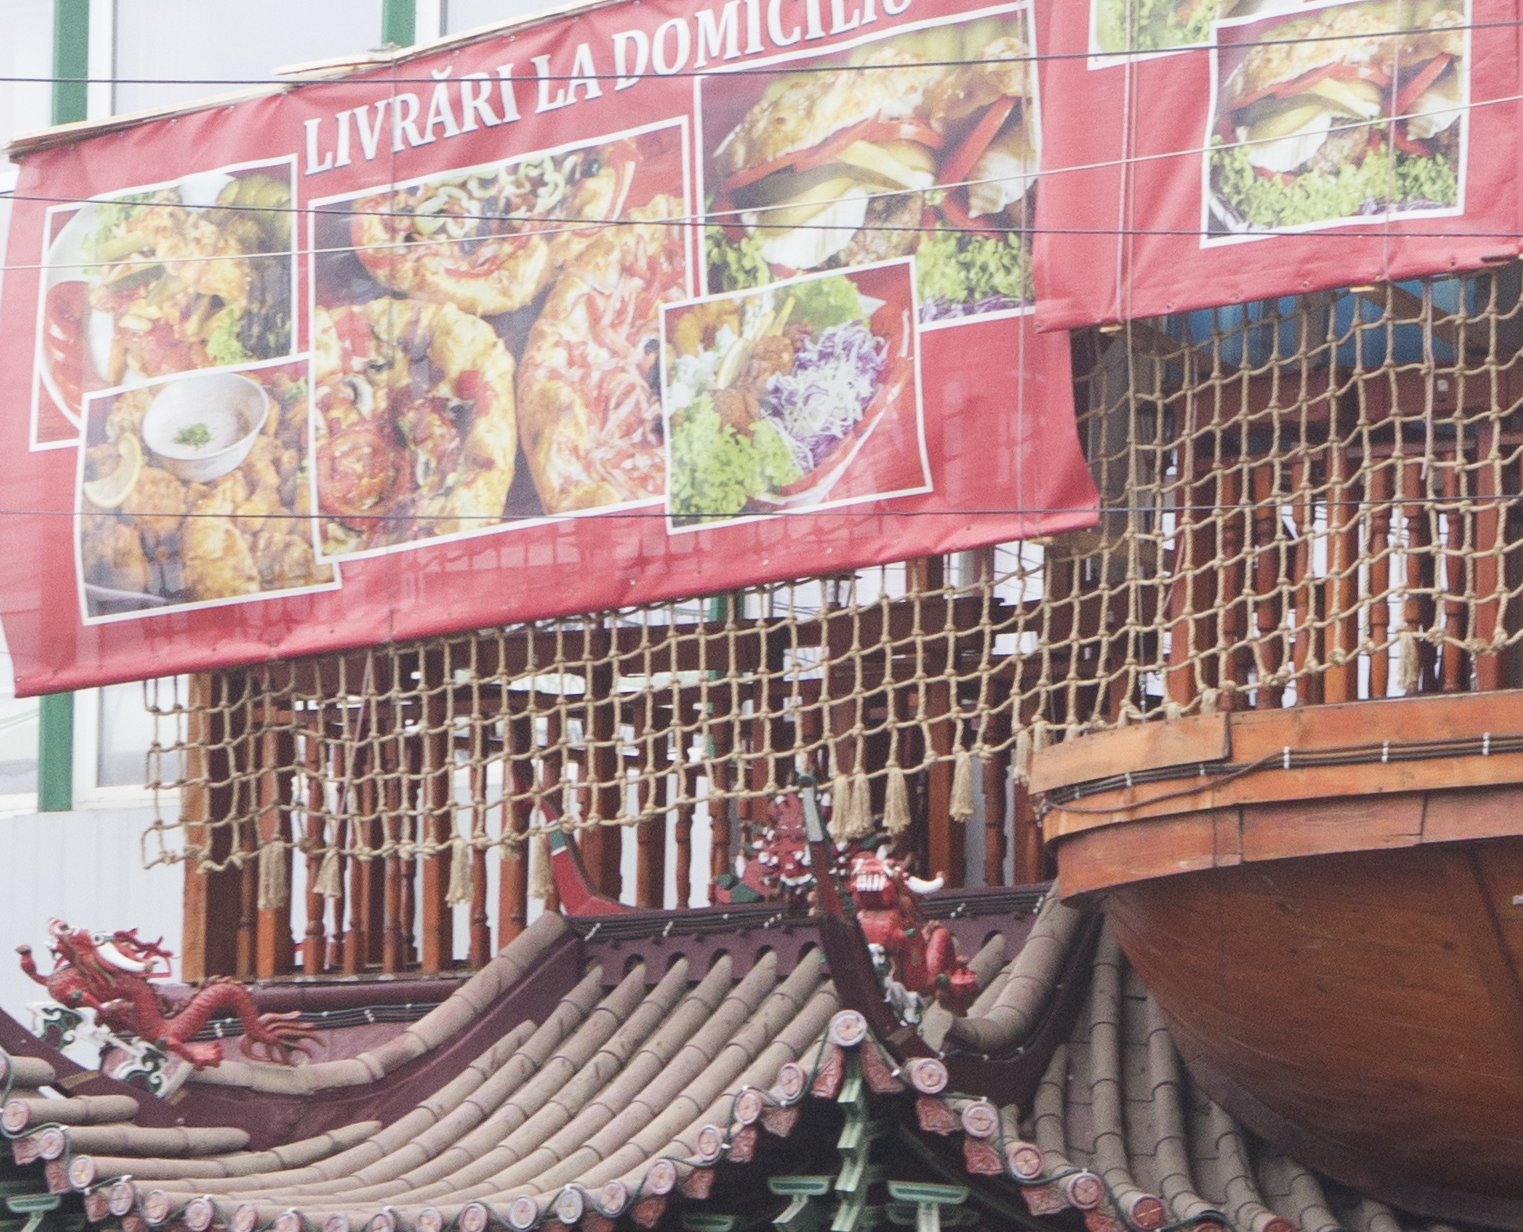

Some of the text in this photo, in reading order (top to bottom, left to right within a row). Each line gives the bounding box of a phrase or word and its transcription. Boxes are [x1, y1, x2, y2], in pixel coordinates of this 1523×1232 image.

[304, 0, 913, 176] LIVRĂRI LA DOMICIL
